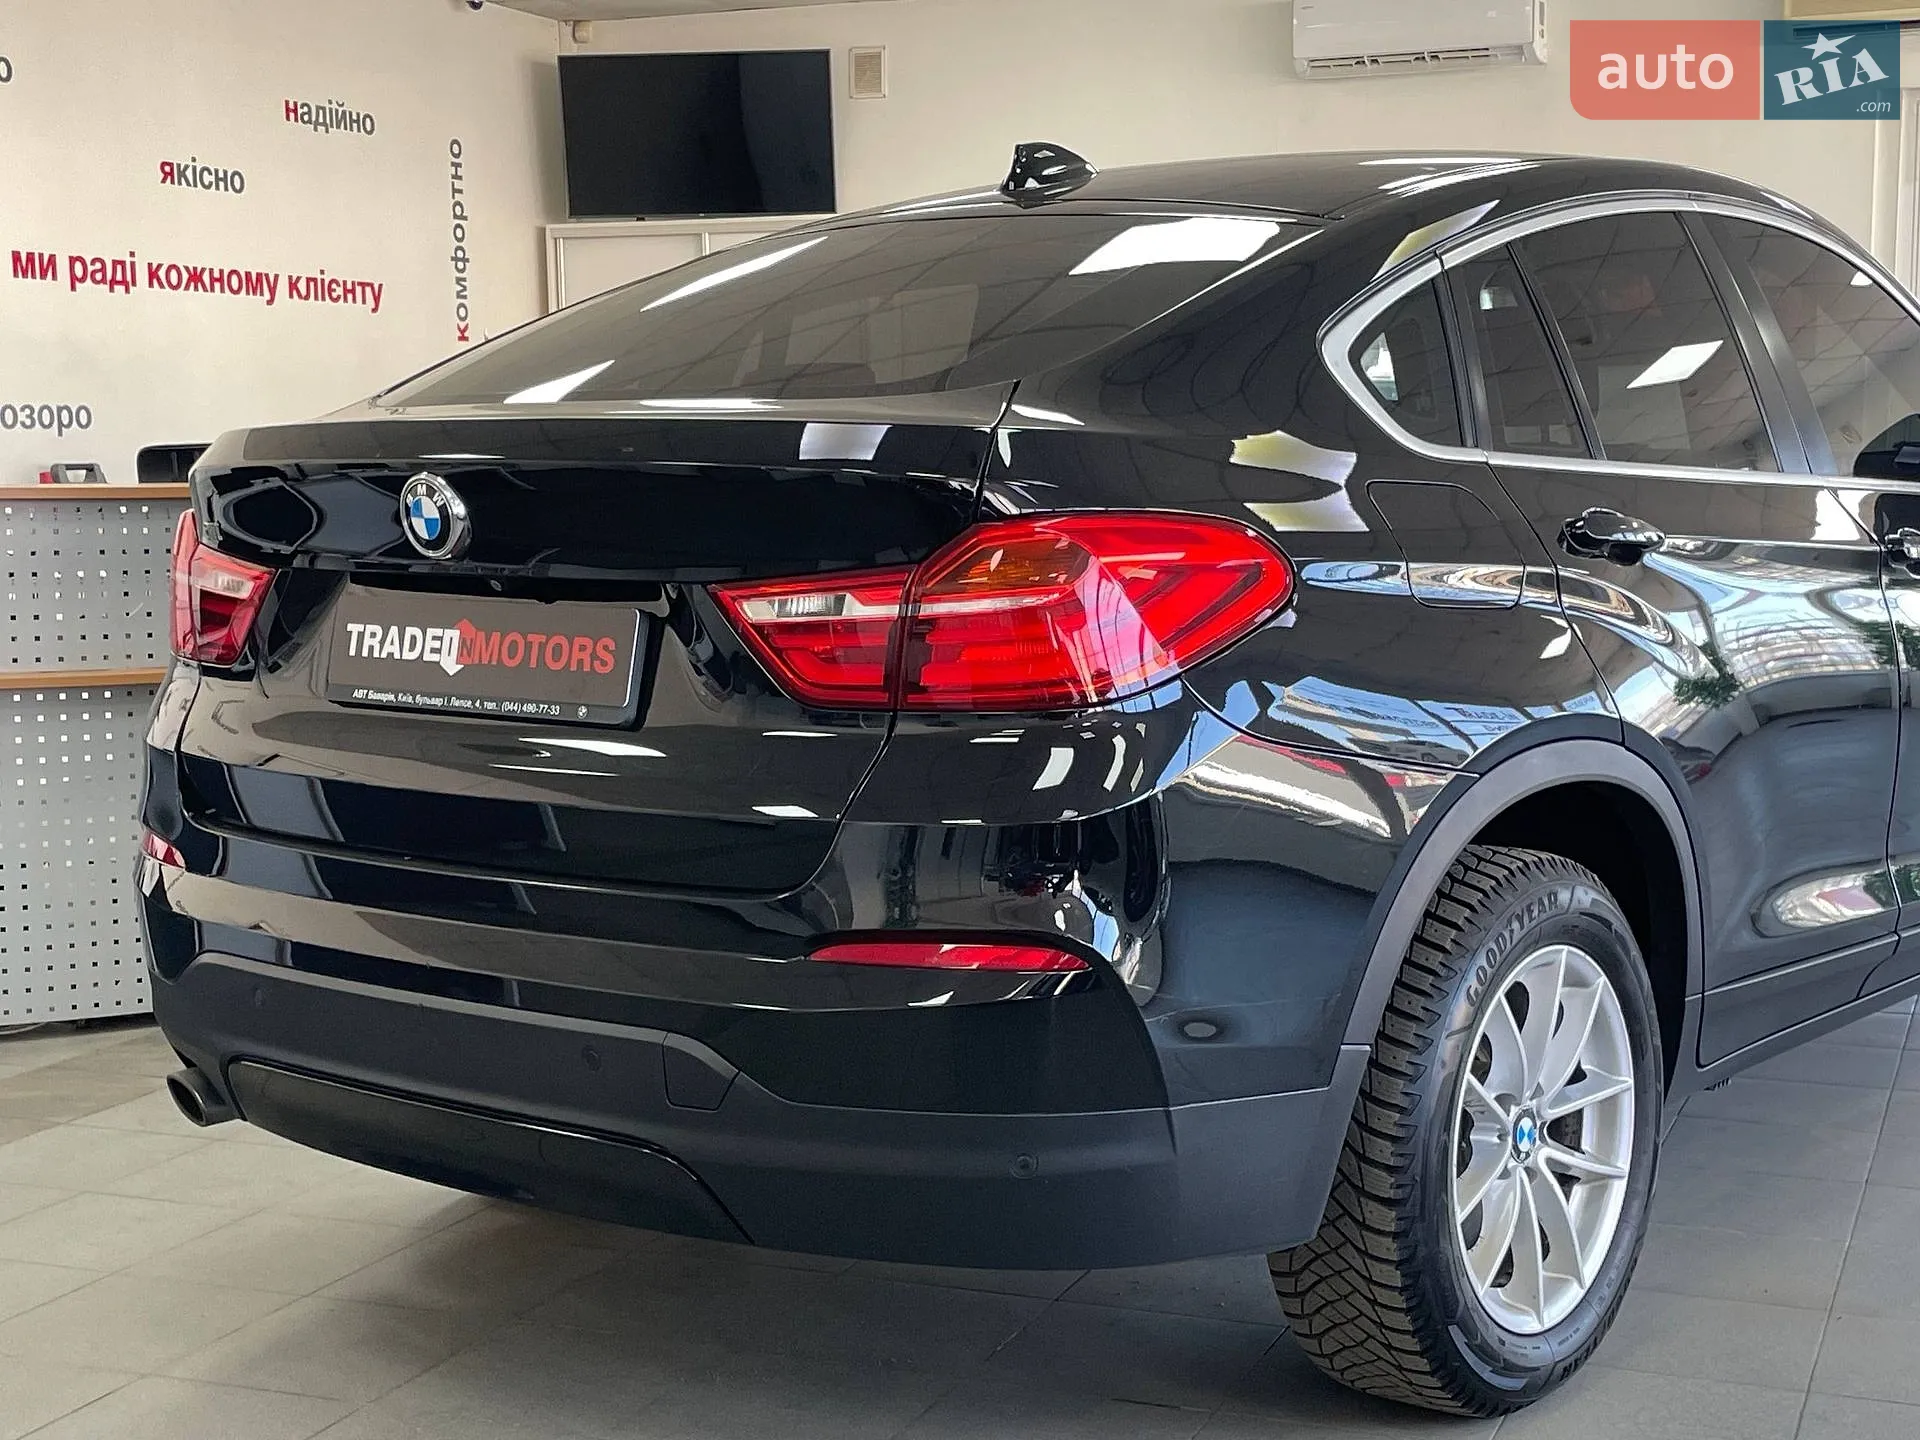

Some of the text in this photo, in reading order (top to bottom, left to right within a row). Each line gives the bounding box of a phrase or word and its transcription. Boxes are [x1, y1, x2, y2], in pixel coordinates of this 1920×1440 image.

[284, 99, 375, 136] надійно
[159, 156, 245, 194] якісно
[449, 138, 470, 342] комфортно
[11, 250, 383, 313] ми раді кожному клієнту
[1466, 890, 1559, 1007] GOODYEAR
